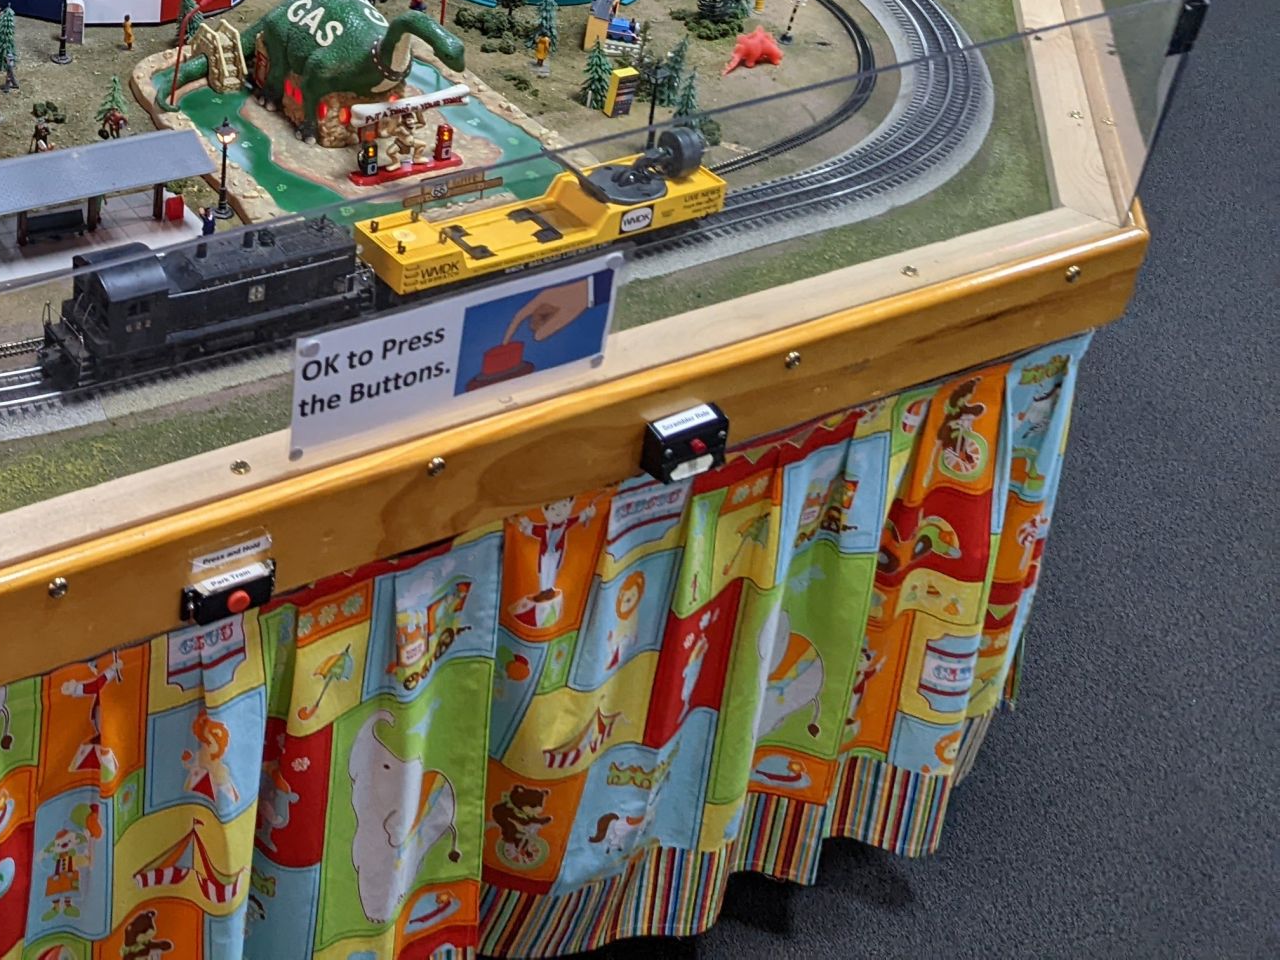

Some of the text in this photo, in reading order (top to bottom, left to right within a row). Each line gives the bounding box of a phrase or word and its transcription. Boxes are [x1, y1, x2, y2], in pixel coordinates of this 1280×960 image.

[421, 261, 460, 279] WMDK
[302, 327, 445, 381] OK to Press
[298, 361, 451, 417] the Buttons.
[202, 542, 261, 565] Press and Hold
[210, 569, 251, 587] Park Train
